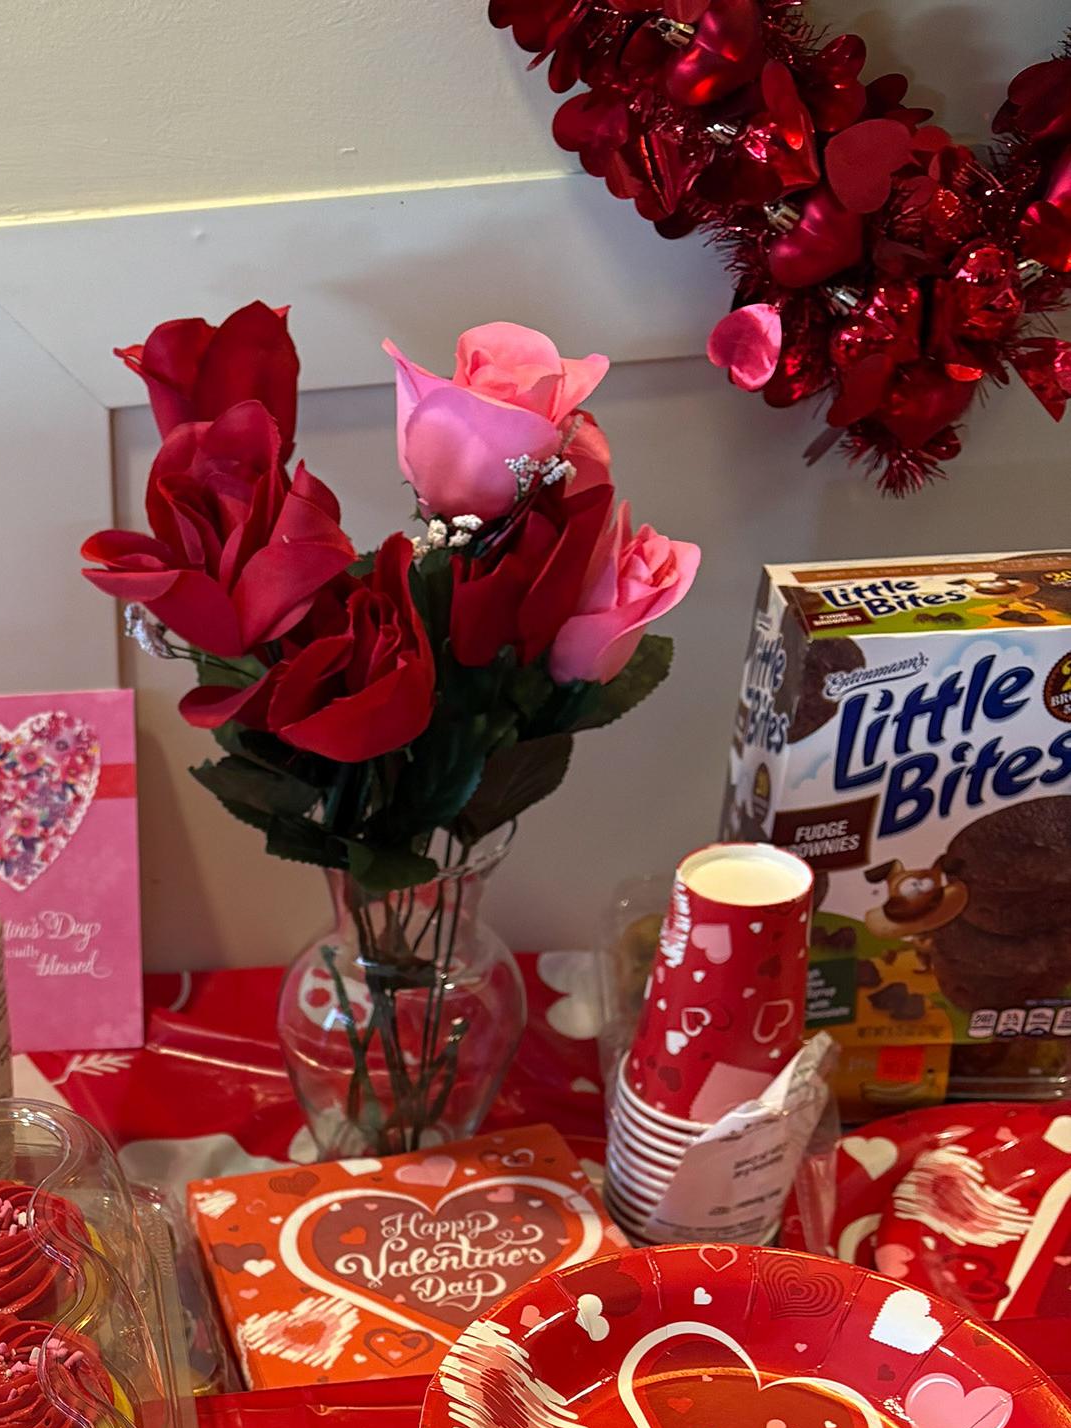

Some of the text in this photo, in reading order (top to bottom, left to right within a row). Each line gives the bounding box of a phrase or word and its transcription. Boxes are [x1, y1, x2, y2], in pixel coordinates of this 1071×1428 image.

[822, 579, 920, 608] Little
[864, 587, 968, 618] Bites
[835, 654, 1035, 791] Little
[878, 729, 1071, 839] Bites
[794, 819, 850, 843] FUDGE
[39, 910, 101, 952] Day
[381, 1210, 499, 1243] Happy
[335, 1224, 547, 1289] Valentine's
[410, 1271, 507, 1313] Day
